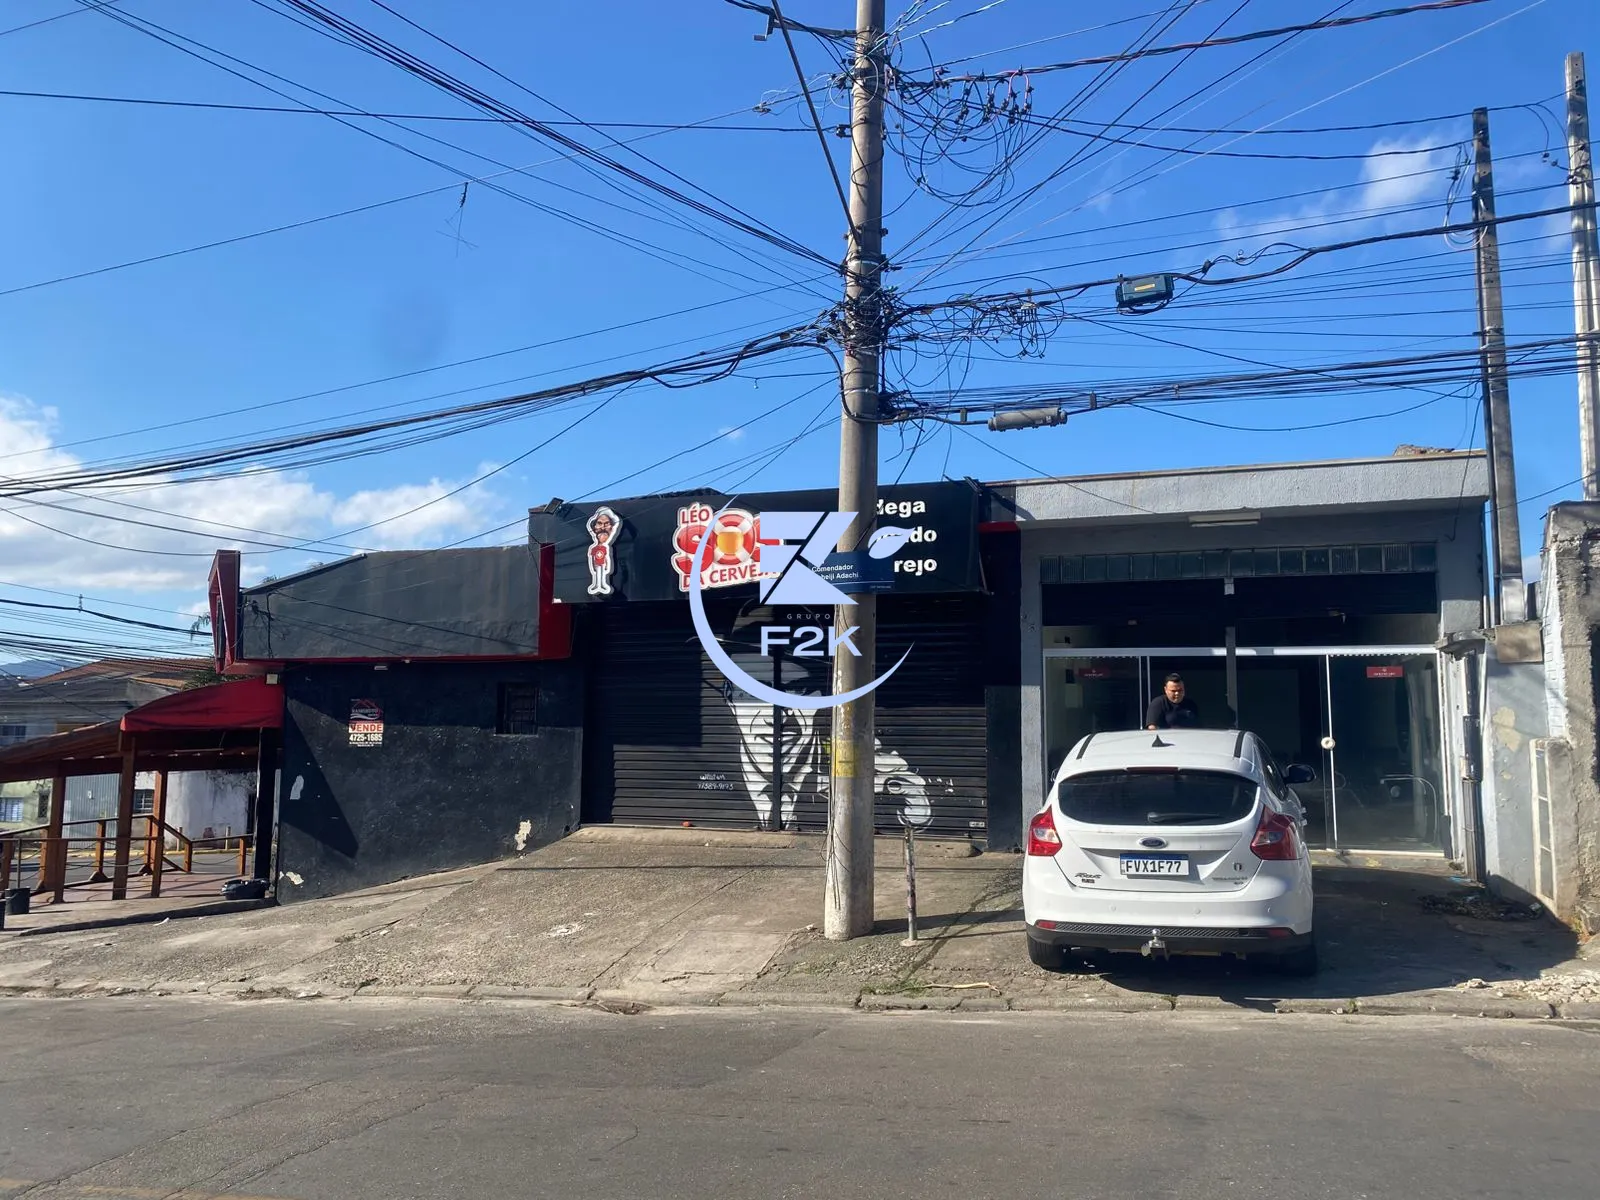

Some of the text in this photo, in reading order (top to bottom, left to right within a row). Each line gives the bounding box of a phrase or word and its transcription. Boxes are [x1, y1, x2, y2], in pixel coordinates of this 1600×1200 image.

[681, 505, 710, 524] LÉO
[709, 564, 778, 583] CERVE
[811, 564, 854, 573] Comendador
[893, 558, 938, 577] rejo
[350, 724, 382, 732] VENDE
[1126, 860, 1182, 873] FVX1F77
